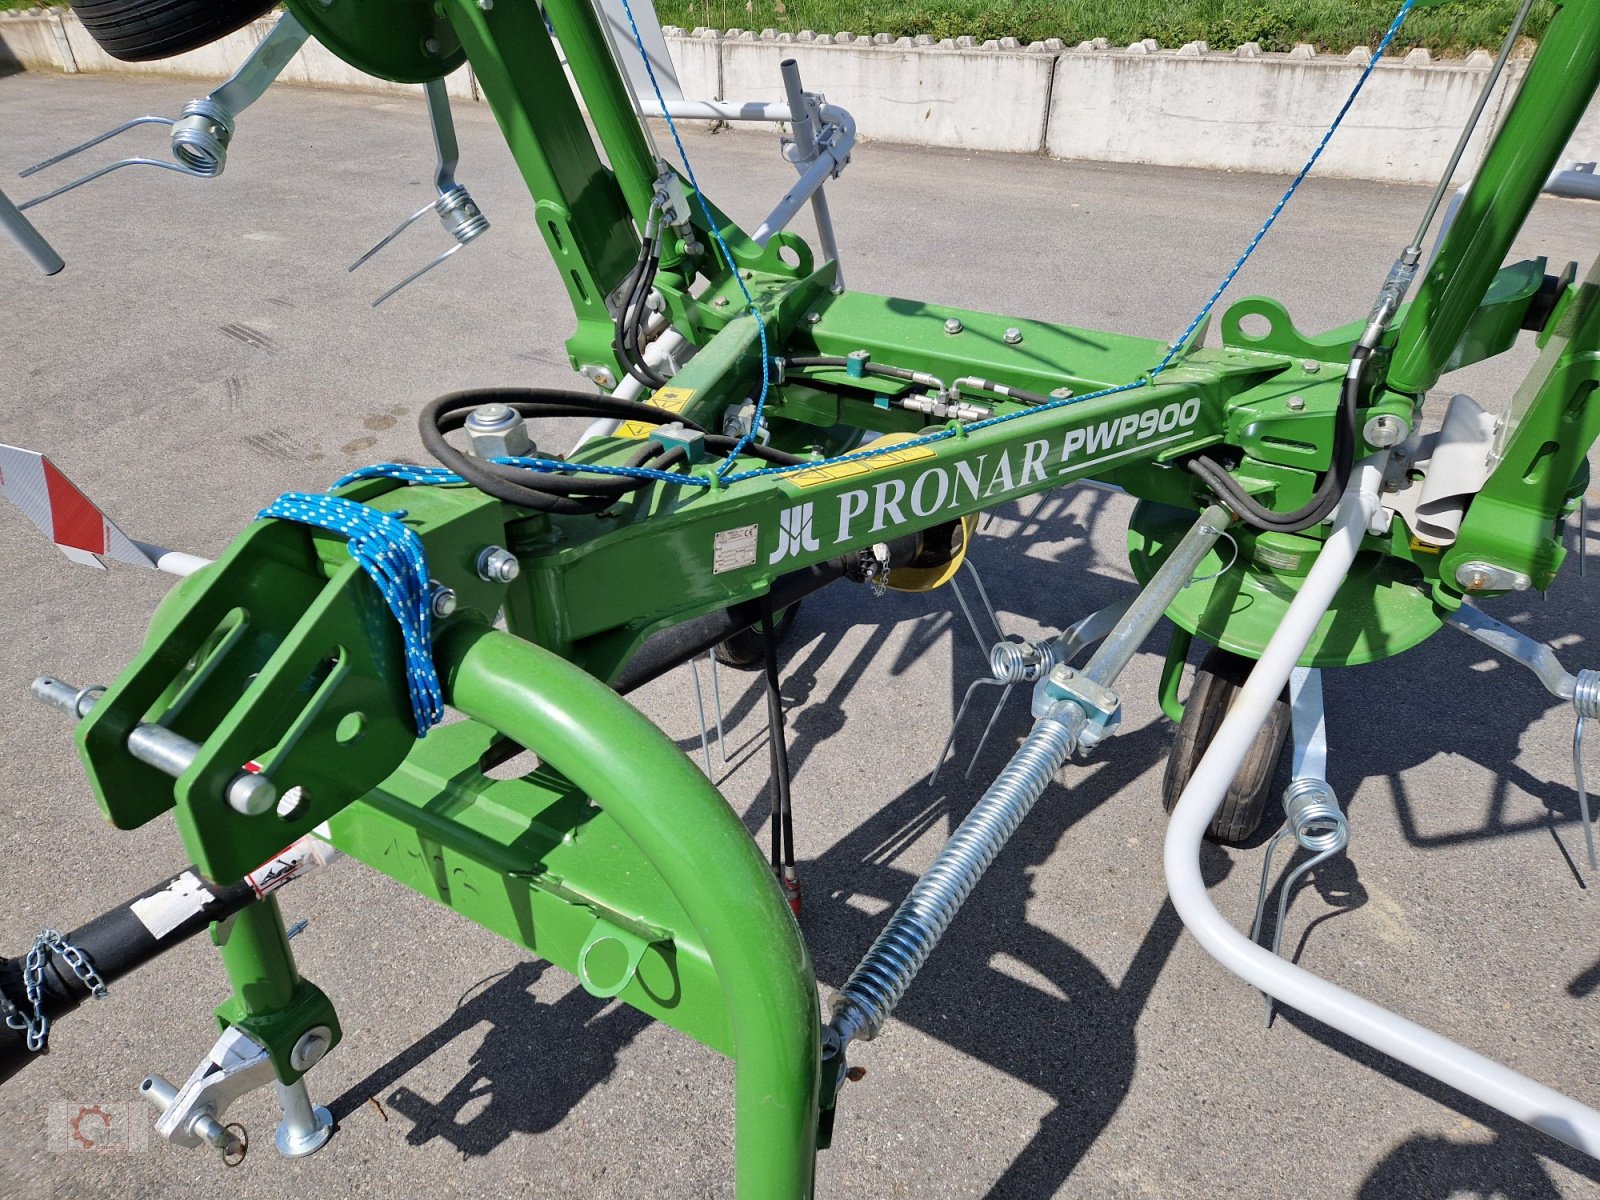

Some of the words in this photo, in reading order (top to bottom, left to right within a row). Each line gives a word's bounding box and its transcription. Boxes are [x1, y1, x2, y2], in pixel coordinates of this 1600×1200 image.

[833, 439, 1049, 544] PRONAR
[1061, 397, 1201, 461] PWP900
[744, 528, 754, 537] CE
